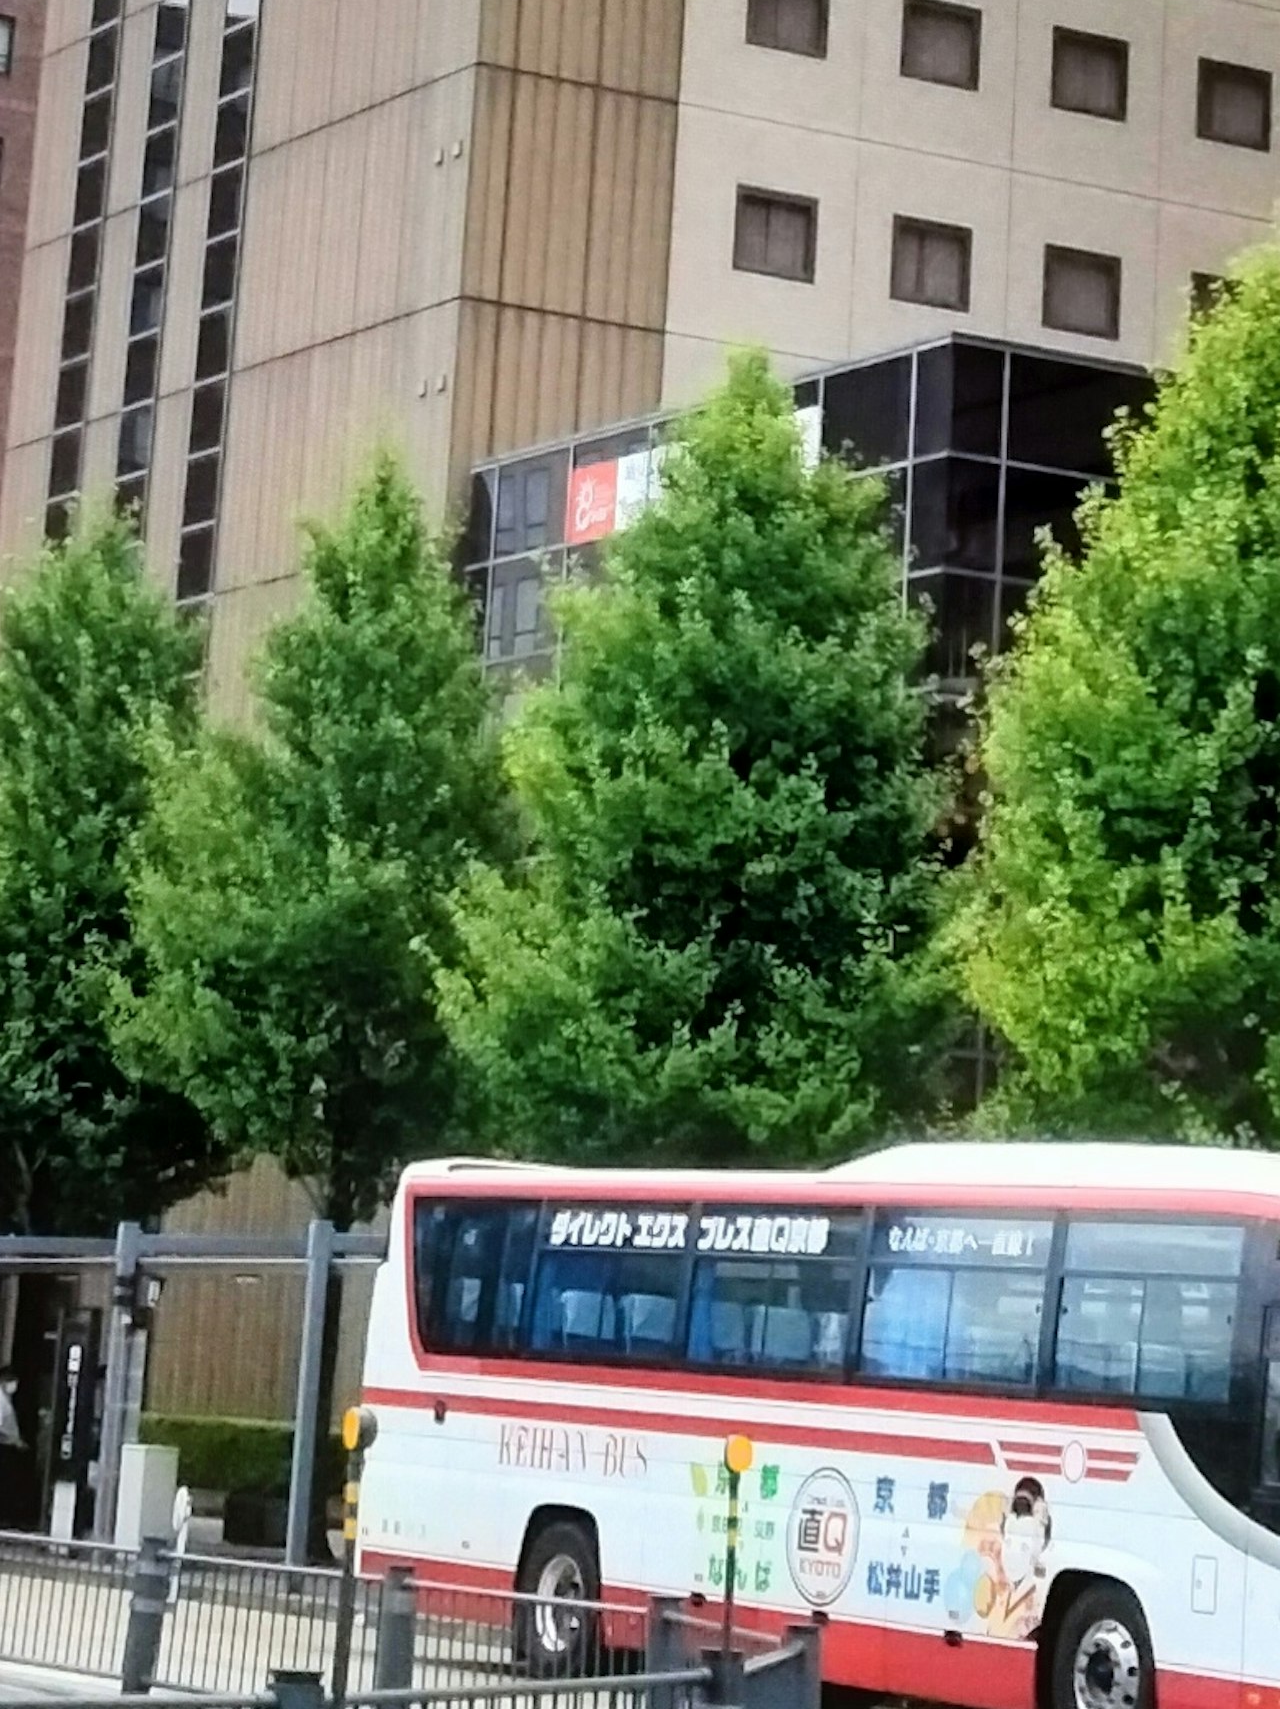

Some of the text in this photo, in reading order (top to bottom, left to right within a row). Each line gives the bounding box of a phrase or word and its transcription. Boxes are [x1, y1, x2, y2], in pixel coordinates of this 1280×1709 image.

[498, 1423, 648, 1478] KEIHAN BUS
[799, 1557, 843, 1579] KYOTO
